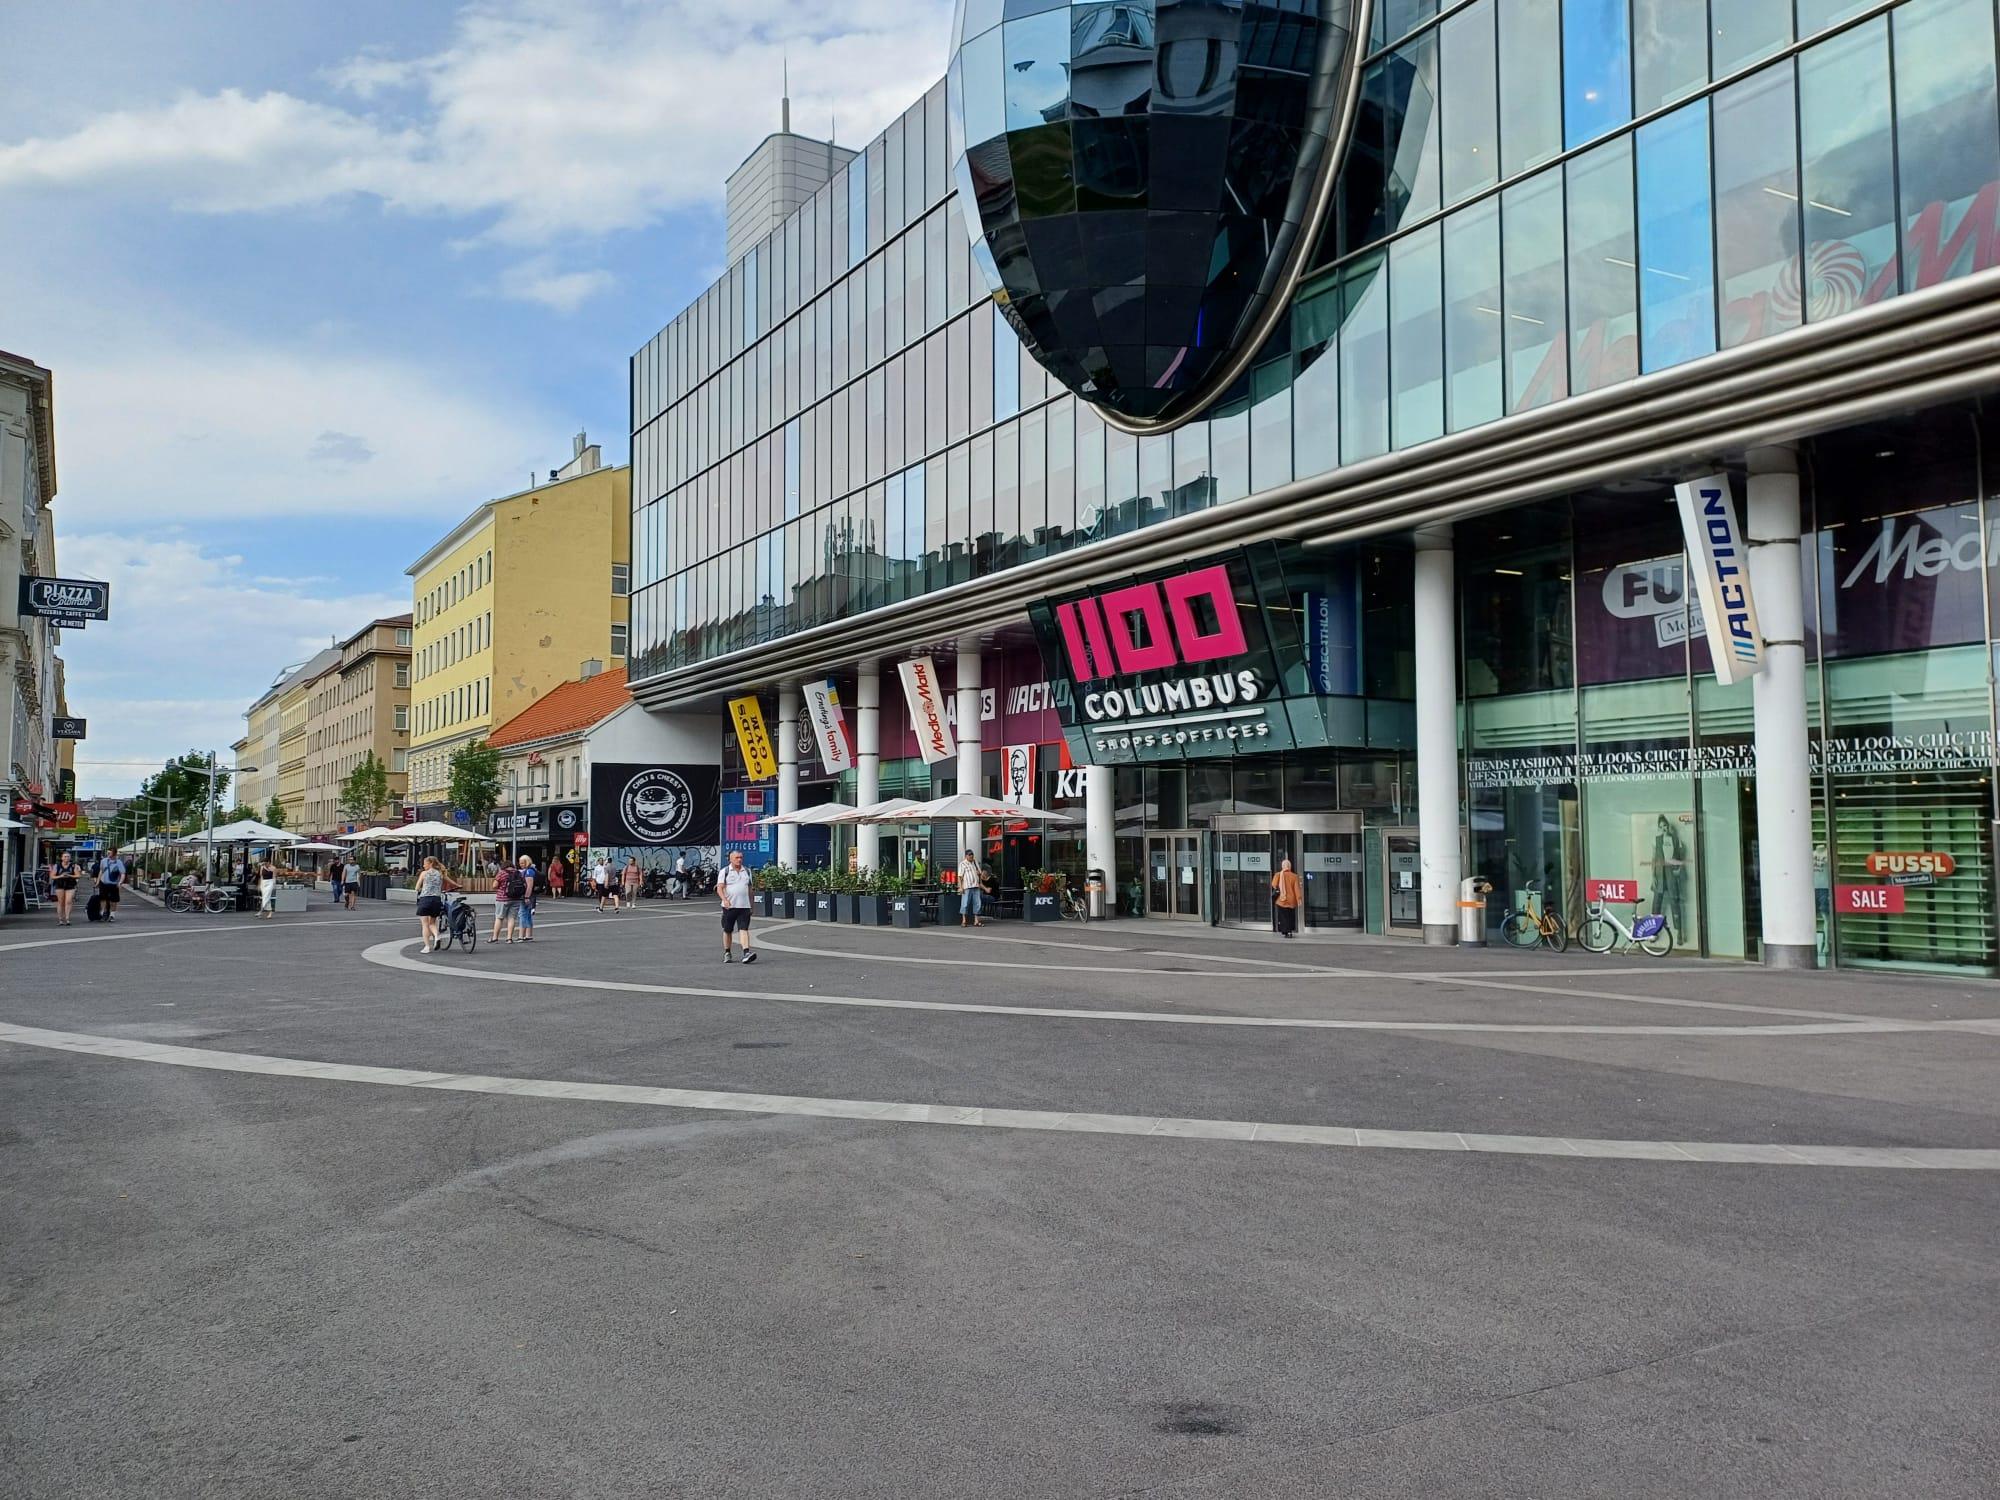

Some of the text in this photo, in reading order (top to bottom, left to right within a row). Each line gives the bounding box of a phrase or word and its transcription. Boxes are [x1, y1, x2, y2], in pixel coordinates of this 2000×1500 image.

[43, 584, 93, 602] PIAZZA
[1056, 565, 1249, 682] 1100
[1319, 597, 1330, 673] DECATHLON
[1084, 670, 1261, 721] COLUMBUS
[913, 663, 948, 757] Media Markt
[737, 703, 762, 775] GOLD'S
[750, 714, 768, 760] GYM
[826, 730, 842, 762] family
[1096, 734, 1156, 752] SHOPS
[1174, 722, 1270, 745] OFFICES
[1809, 738, 1850, 753] NEW
[1854, 734, 1914, 750] LOOKS
[1918, 732, 1964, 747] CHIC
[1467, 759, 1510, 772] TRENDS
[1512, 755, 1563, 770] FASHION
[1565, 753, 1596, 766] NEW
[1598, 751, 1642, 766] LOOKS
[1826, 750, 1894, 764] FEELING
[1900, 745, 1965, 761] DESIGN
[1468, 768, 1523, 781] LIFESTYLE
[1526, 766, 1572, 779] COLOUR
[1631, 760, 1678, 774] DESIGN
[1859, 761, 1897, 772] LOOKS
[1900, 759, 1934, 771] GOOD
[1937, 758, 1966, 770] CHIC
[632, 775, 649, 789] CHILI
[656, 773, 682, 789] CHEESY
[1602, 773, 1629, 783] LOOKS
[1631, 772, 1656, 782] GOOD
[970, 808, 1025, 817] KFC
[725, 842, 757, 851] OFFICES
[1875, 855, 1947, 873] FUSSL
[1598, 883, 1625, 899] SALE
[1851, 889, 1888, 908] SALE
[894, 902, 906, 911] KFC
[1034, 896, 1054, 906] KFC
